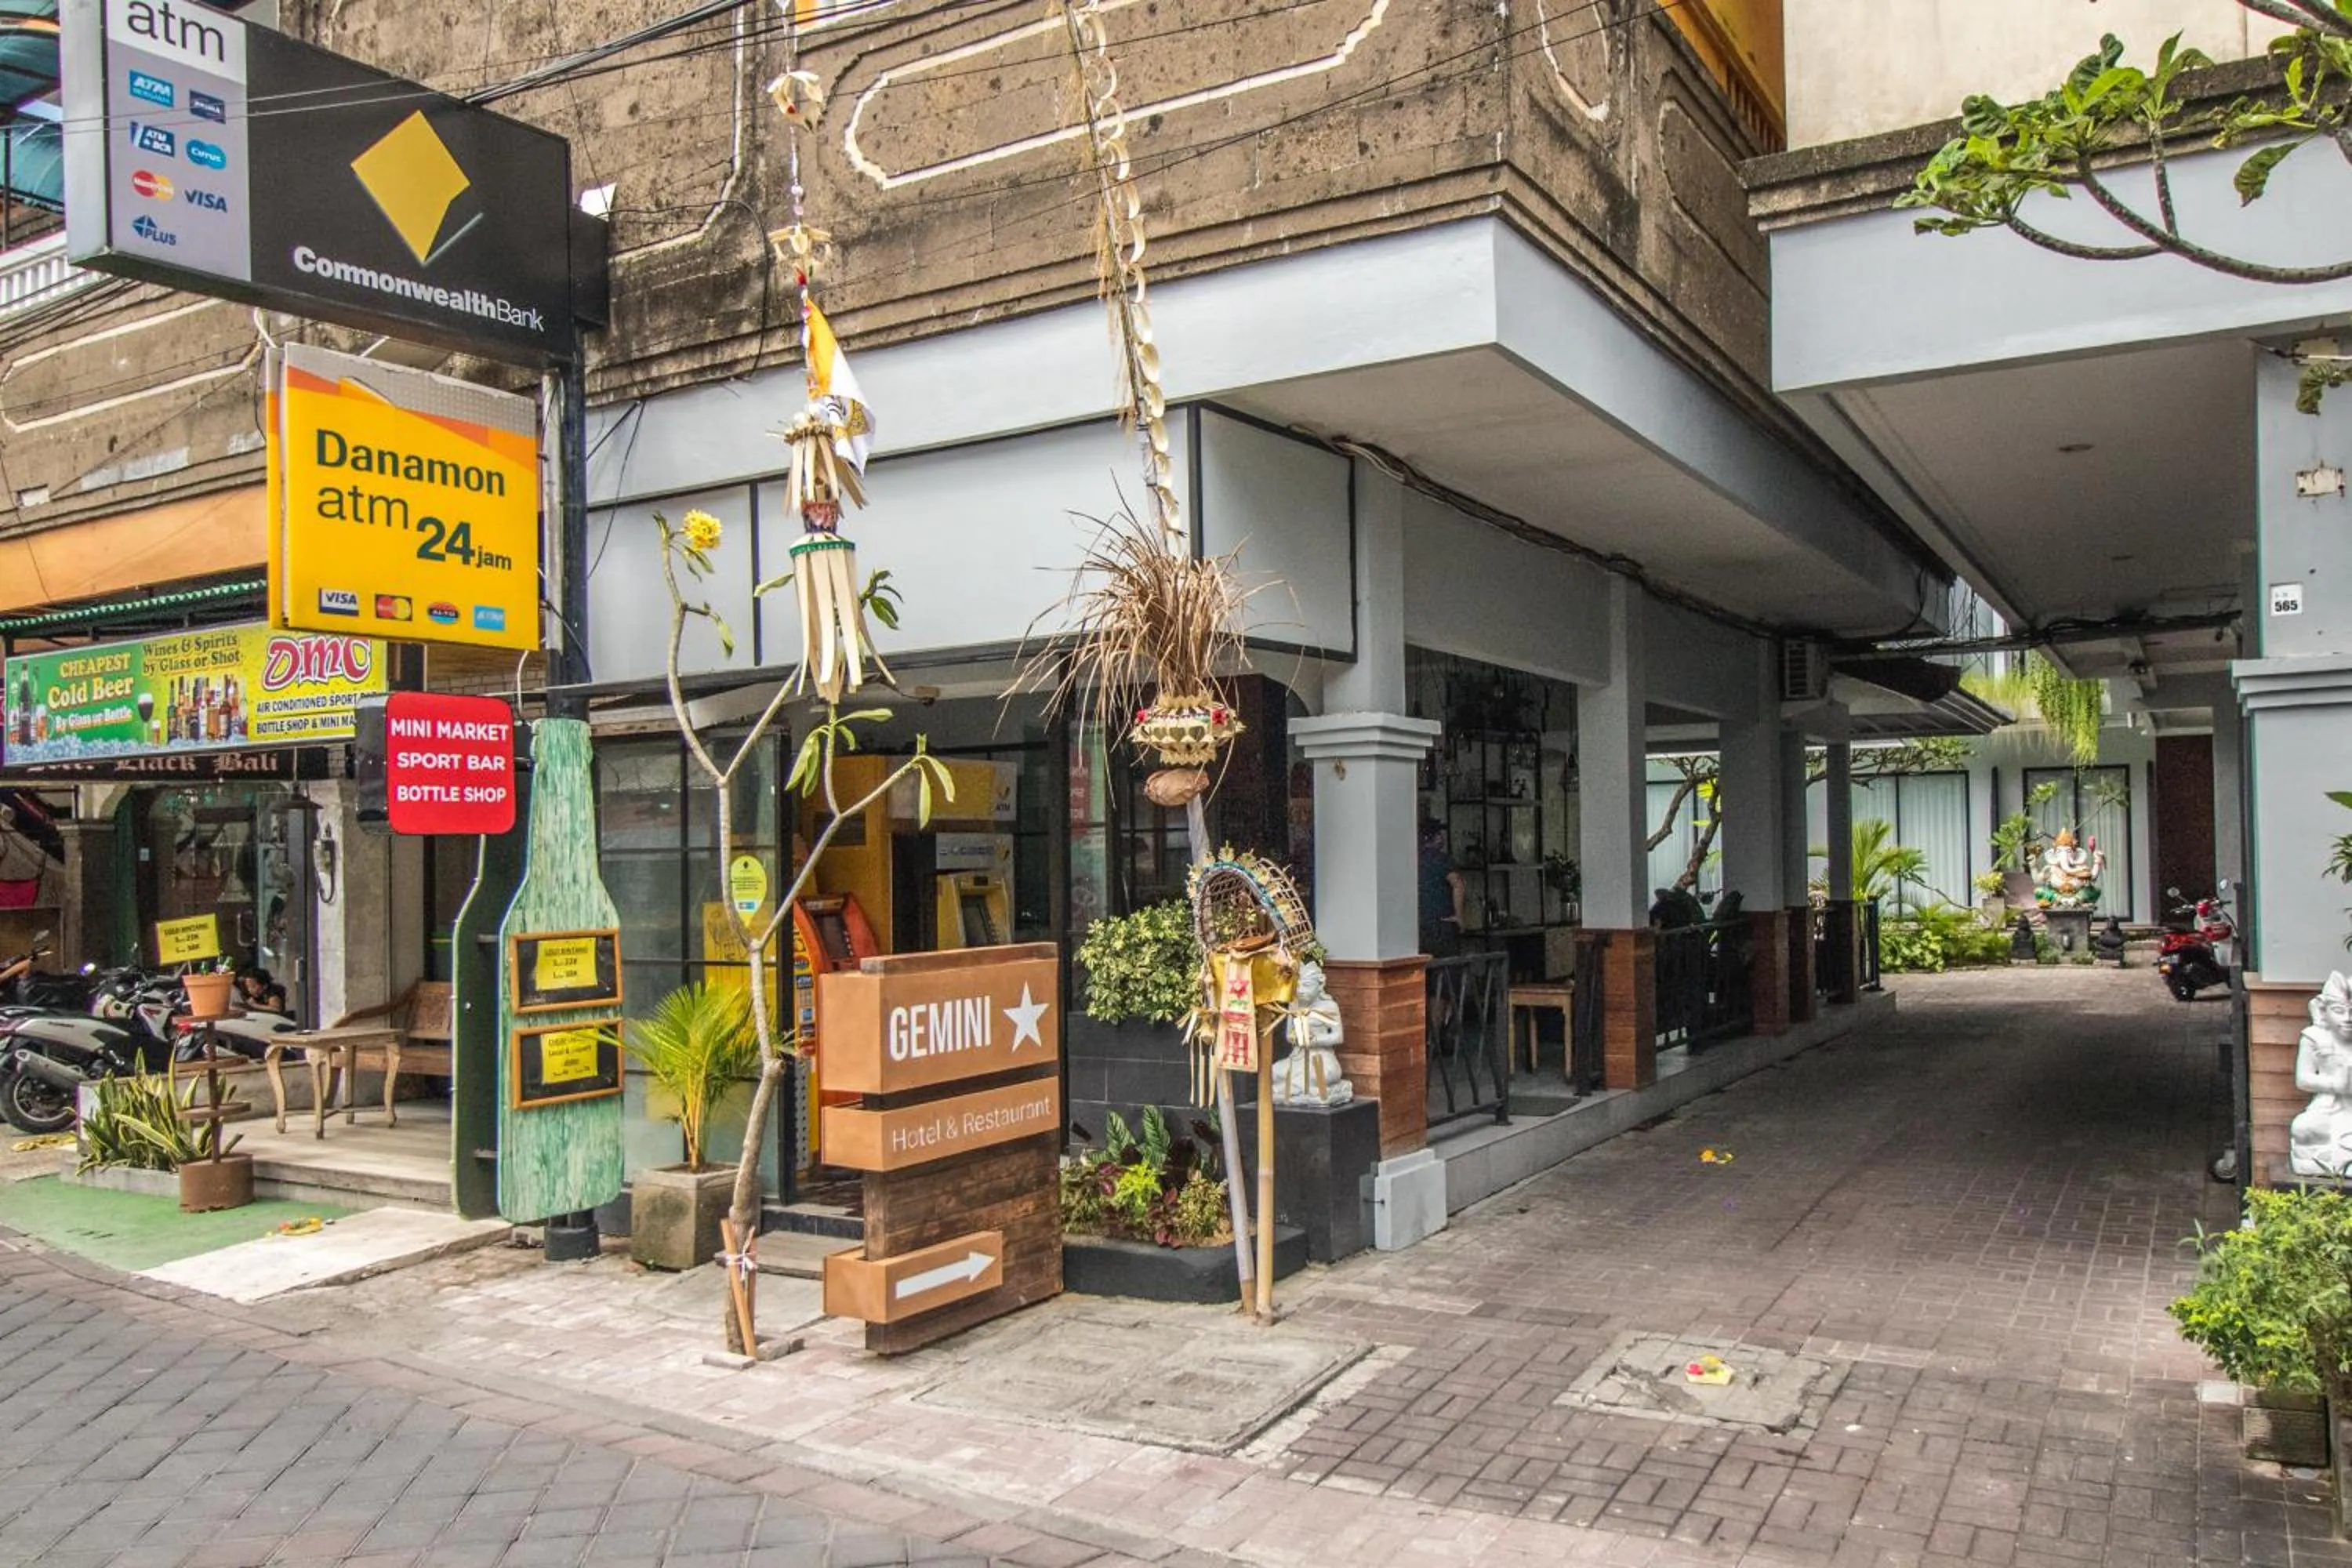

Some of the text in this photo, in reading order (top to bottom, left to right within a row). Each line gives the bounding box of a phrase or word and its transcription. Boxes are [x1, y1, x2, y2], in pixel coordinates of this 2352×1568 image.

[127, 1, 224, 62] atm
[133, 76, 171, 96] ATM
[146, 129, 167, 142] ATM
[183, 188, 227, 213] VISA
[144, 227, 176, 246] PLUS
[293, 245, 545, 333] CommonwealthBank
[316, 428, 506, 497] Danamon
[317, 484, 513, 571] atm 24 jam
[325, 591, 358, 605] VISA
[2274, 600, 2299, 612] 565
[143, 643, 178, 656] Wines
[194, 633, 238, 653] Spirits
[60, 652, 132, 678] CHEAPEST
[143, 650, 240, 676] by Glass or Shot
[48, 676, 134, 710] Cold Beer
[256, 701, 270, 713] AIR
[272, 696, 328, 712] CONDITIONED
[329, 692, 358, 707] SPORT
[256, 720, 284, 734] BOTTLE
[286, 719, 310, 732] SHOP
[320, 715, 339, 728] MINI
[391, 718, 509, 741] MINI MARKET
[212, 752, 278, 772] Bali
[397, 752, 506, 771] SPORT BAR
[397, 786, 506, 803] BOTTLE SHOP
[889, 995, 992, 1062] GEMINI
[892, 1095, 1052, 1152] Hotel & Restaurant
